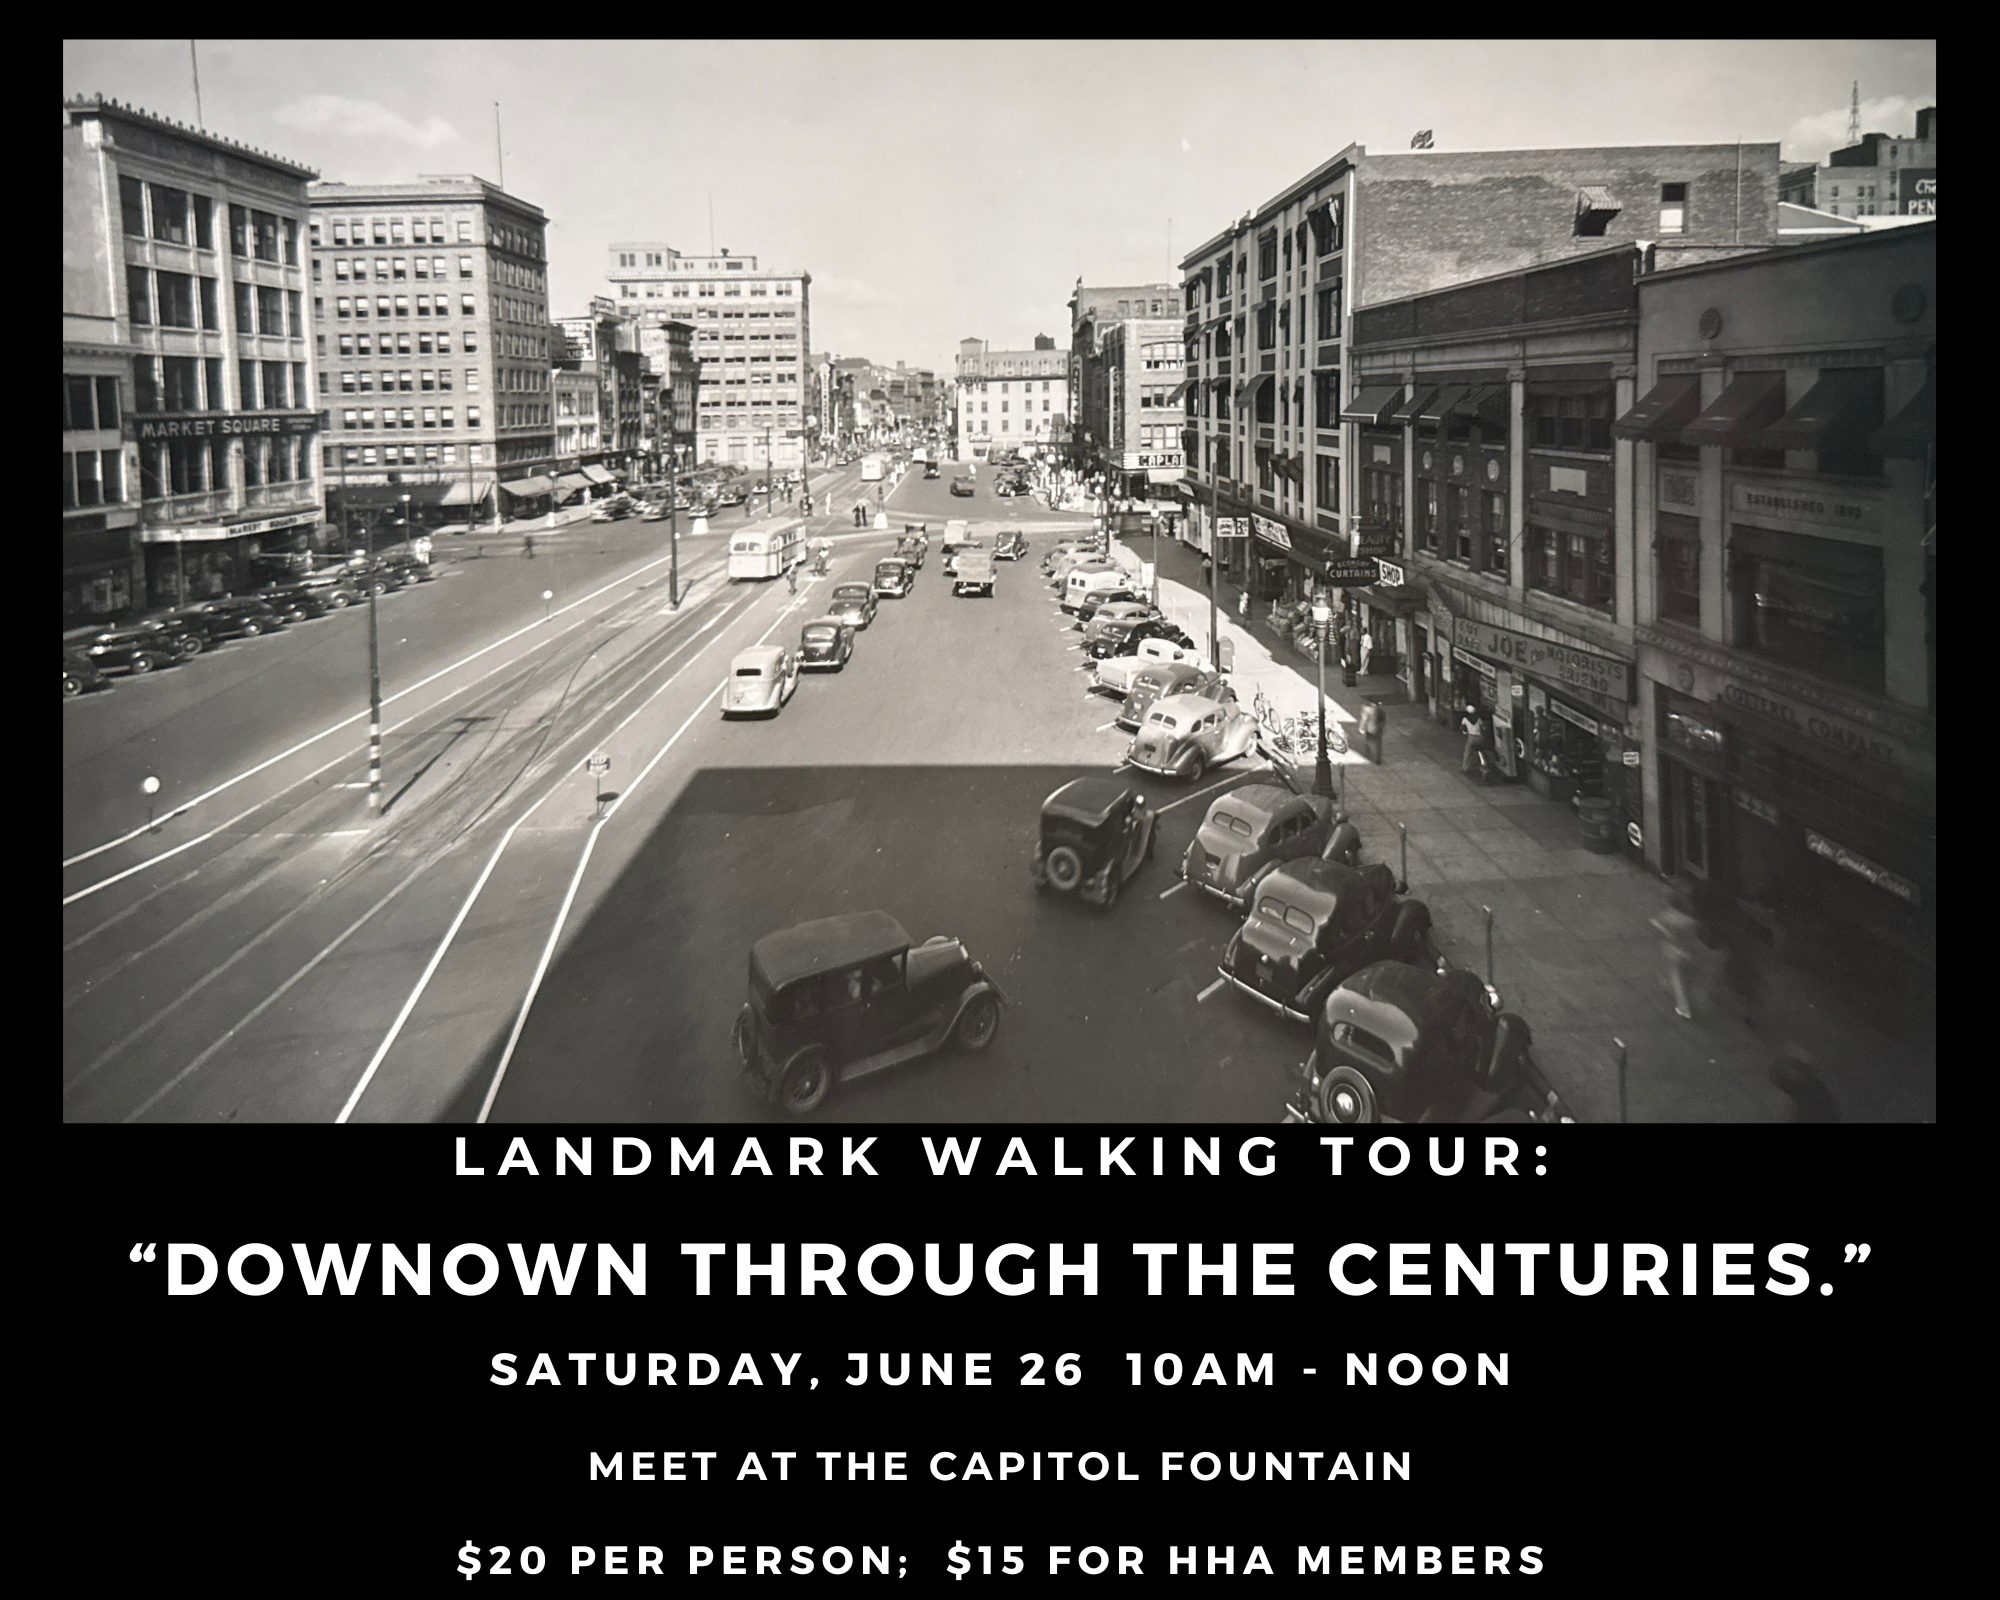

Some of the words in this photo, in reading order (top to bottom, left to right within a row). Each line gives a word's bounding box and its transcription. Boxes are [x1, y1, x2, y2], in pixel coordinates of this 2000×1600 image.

[142, 420, 215, 438] MARKET
[222, 418, 281, 434] SQUARE
[1747, 492, 1825, 514] ESTABLISHED
[1329, 569, 1378, 579] CURTAINS
[1381, 564, 1401, 585] SHOP
[1487, 633, 1528, 665] JOE
[1547, 645, 1622, 680] MOTORISTS
